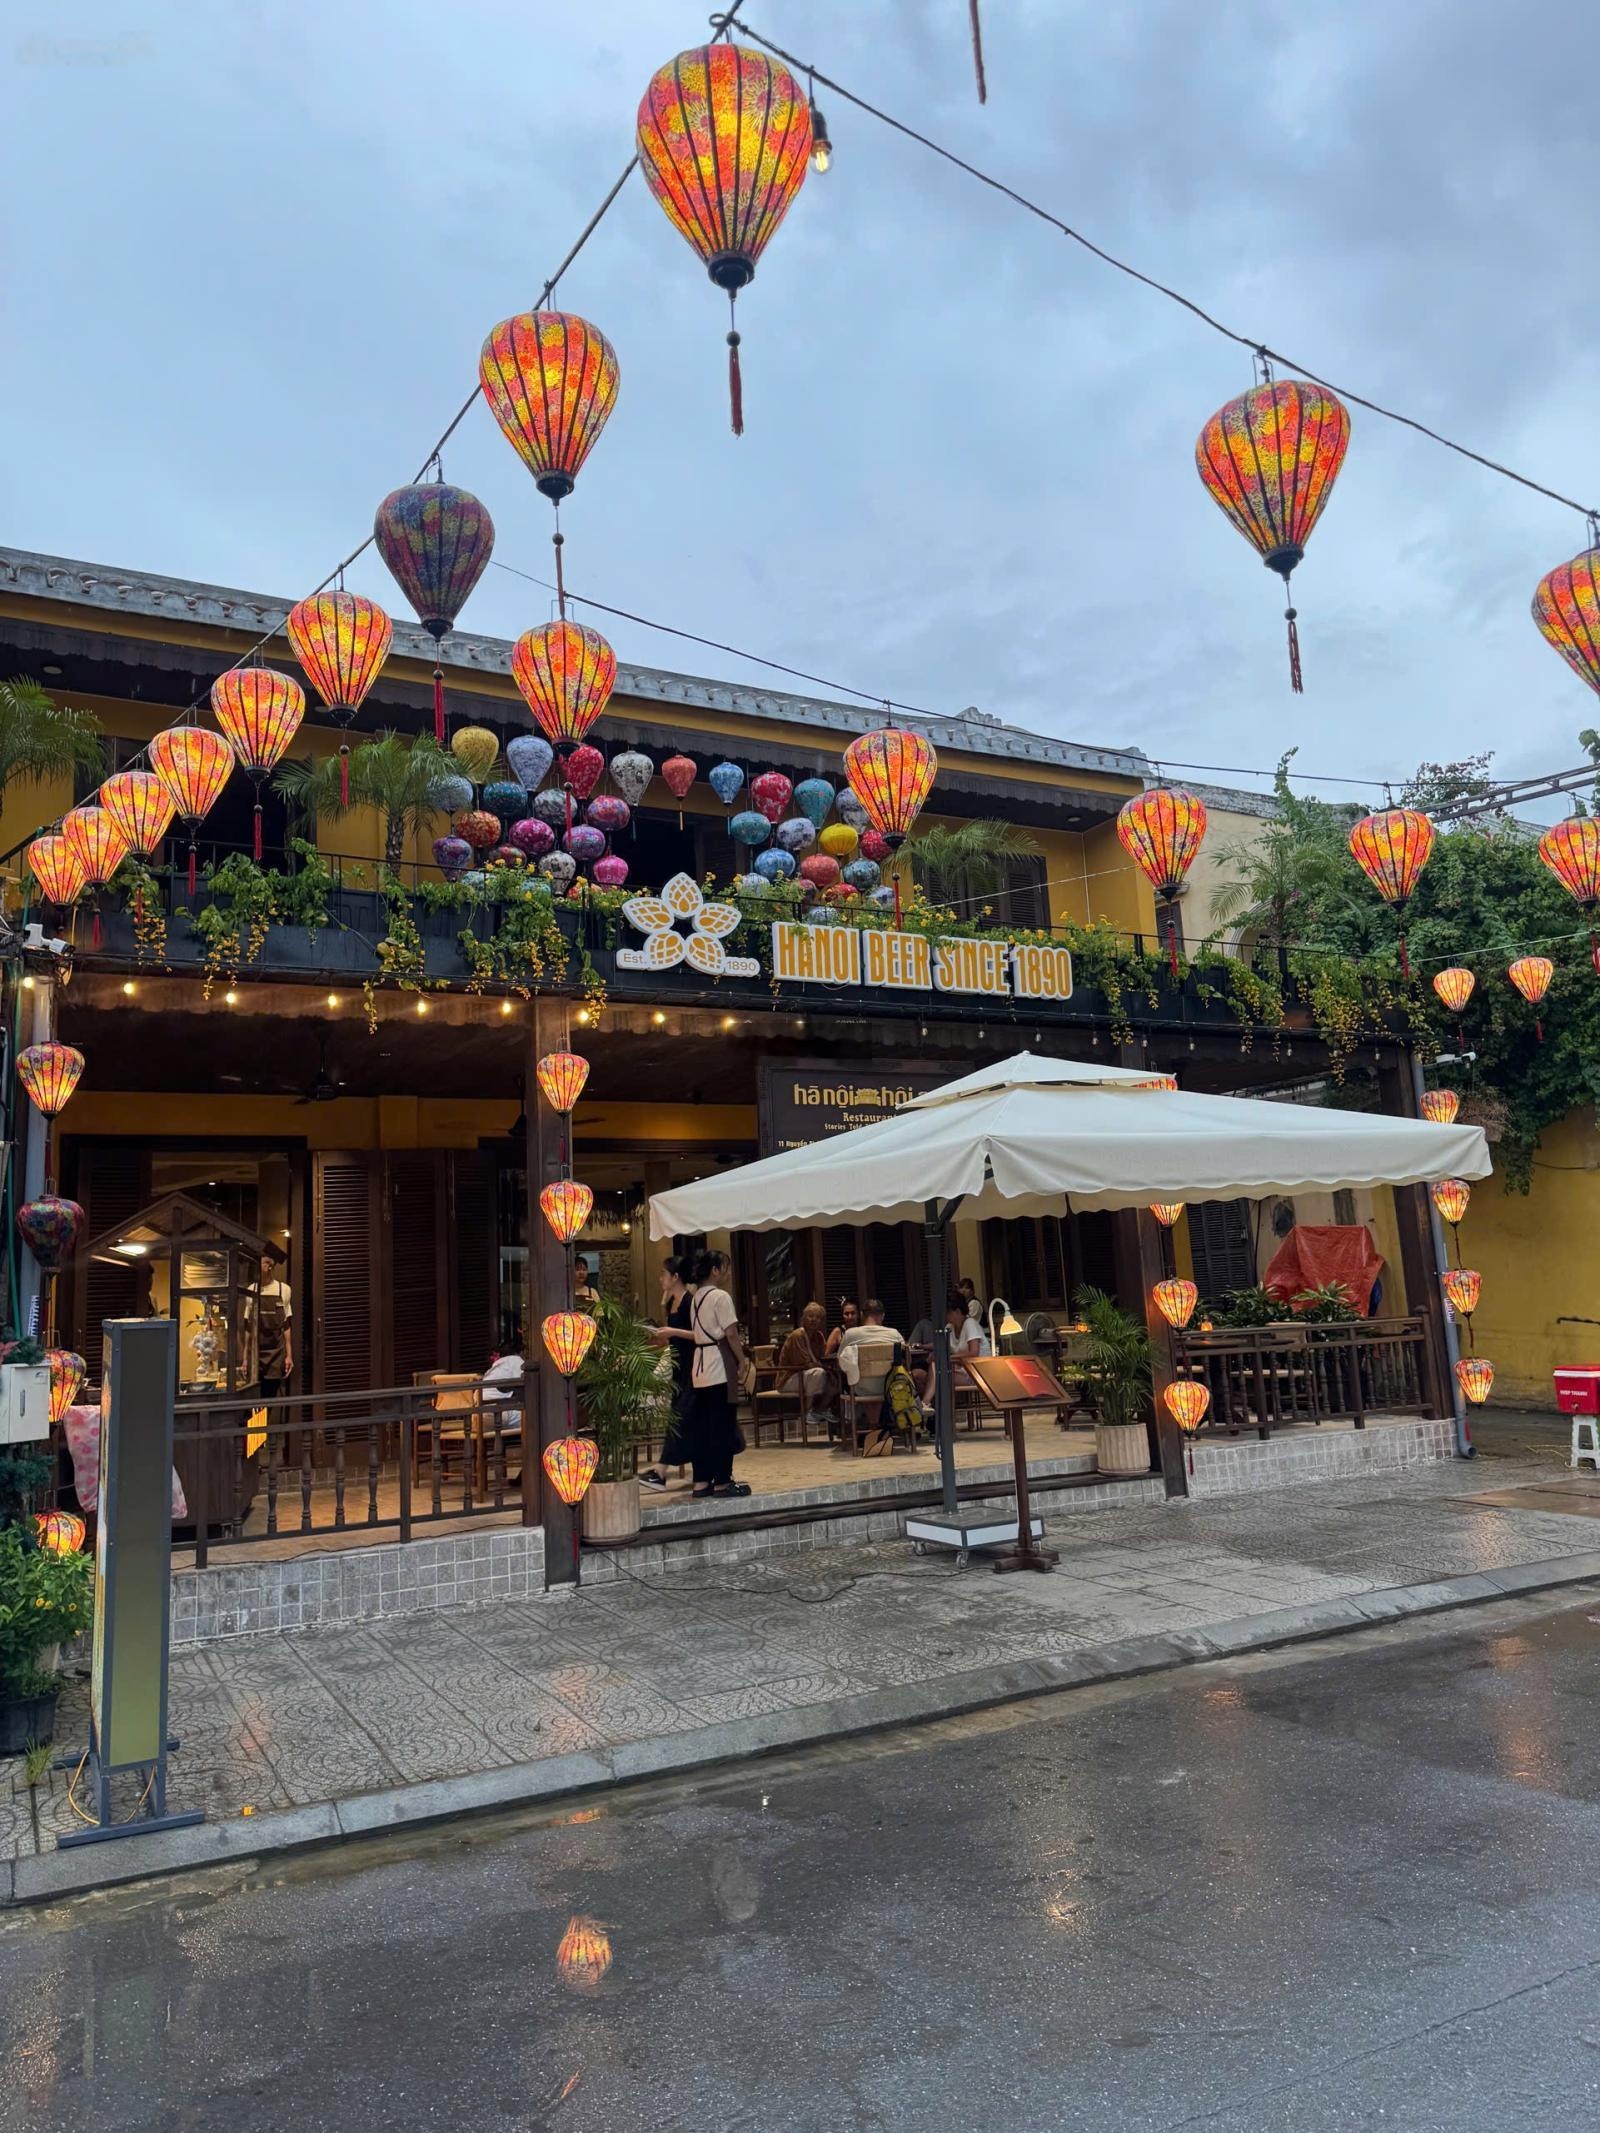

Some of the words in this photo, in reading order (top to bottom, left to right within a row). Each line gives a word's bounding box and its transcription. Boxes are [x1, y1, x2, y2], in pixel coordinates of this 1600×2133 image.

[623, 952, 647, 965] Est.
[727, 960, 757, 972] 1890
[777, 923, 860, 982] HANOI
[868, 931, 931, 987] BEER
[938, 939, 1008, 993] SINCE
[1015, 947, 1072, 998] 1890
